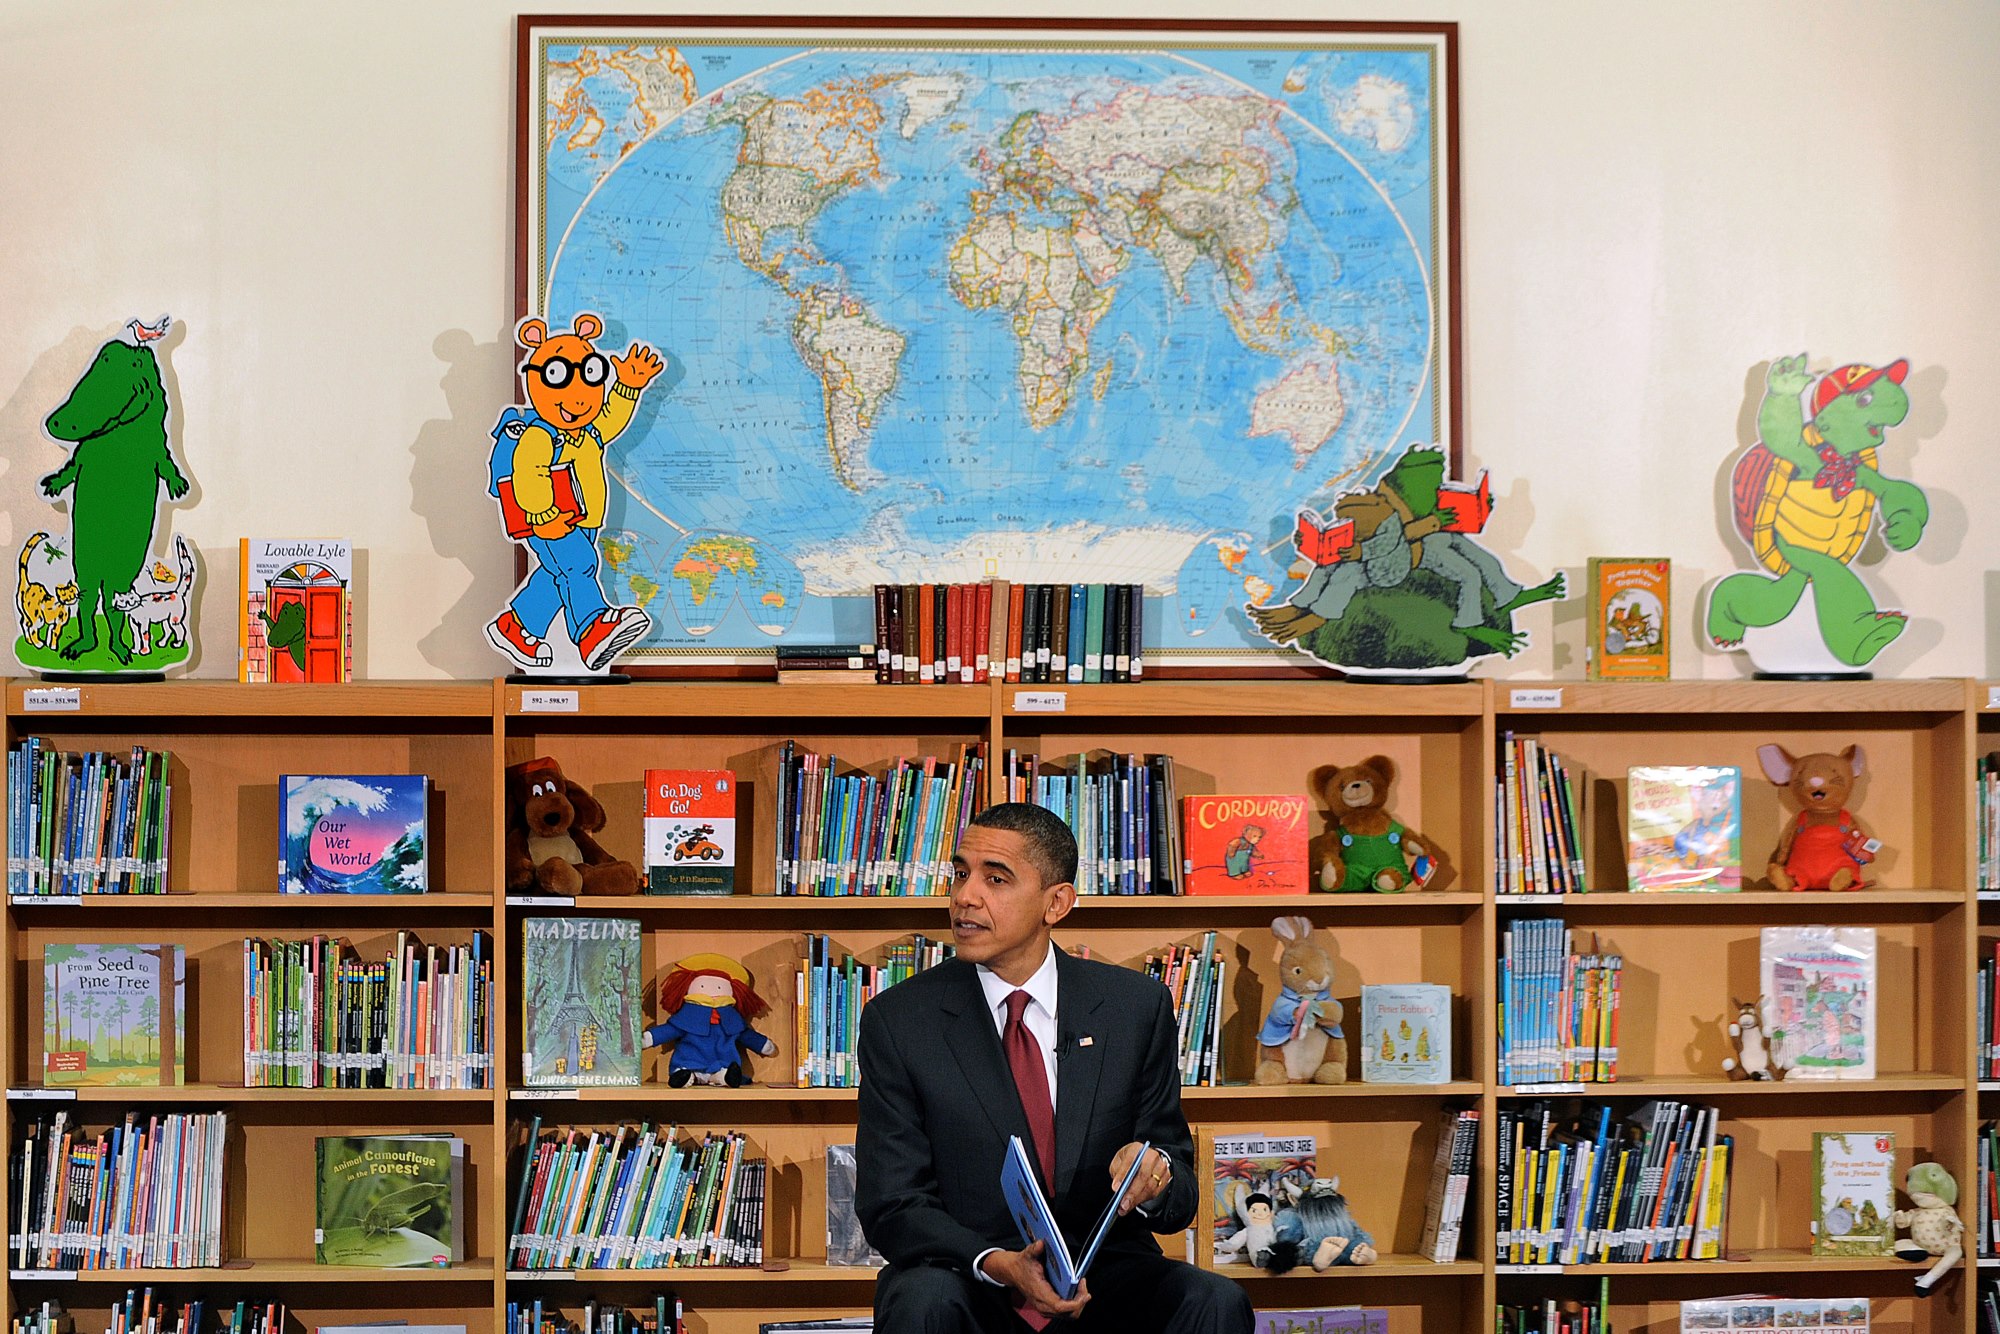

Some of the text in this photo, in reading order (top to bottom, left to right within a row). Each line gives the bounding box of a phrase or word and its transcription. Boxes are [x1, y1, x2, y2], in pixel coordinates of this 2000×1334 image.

[642, 167, 693, 182] NORTH
[901, 175, 950, 183] NORTH
[616, 216, 682, 229] PACIFIC
[606, 268, 657, 276] OCEAN
[719, 420, 790, 430] PACIFIC
[745, 464, 798, 476] OCEAN
[264, 543, 346, 560] Lovable Lyle
[670, 800, 690, 814] Go!
[1199, 800, 1304, 832] CORDUROY
[319, 820, 346, 833] Our
[324, 837, 351, 849] Wet
[330, 853, 371, 865] World
[527, 921, 640, 942] MADELINE
[67, 965, 92, 973] From
[98, 956, 134, 972] Seed
[80, 976, 150, 989] Pine Tree
[527, 1075, 639, 1086] LUDWIG BEMELMANS
[1499, 1116, 1507, 1164] ENCYCLOPEDIA
[1215, 1140, 1312, 1155] ERE THE WILD THINGS ARE
[333, 1150, 436, 1173] Animal Camouflage
[356, 1170, 368, 1178] the
[370, 1163, 420, 1176] Forest
[1498, 1174, 1510, 1217] SPACE
